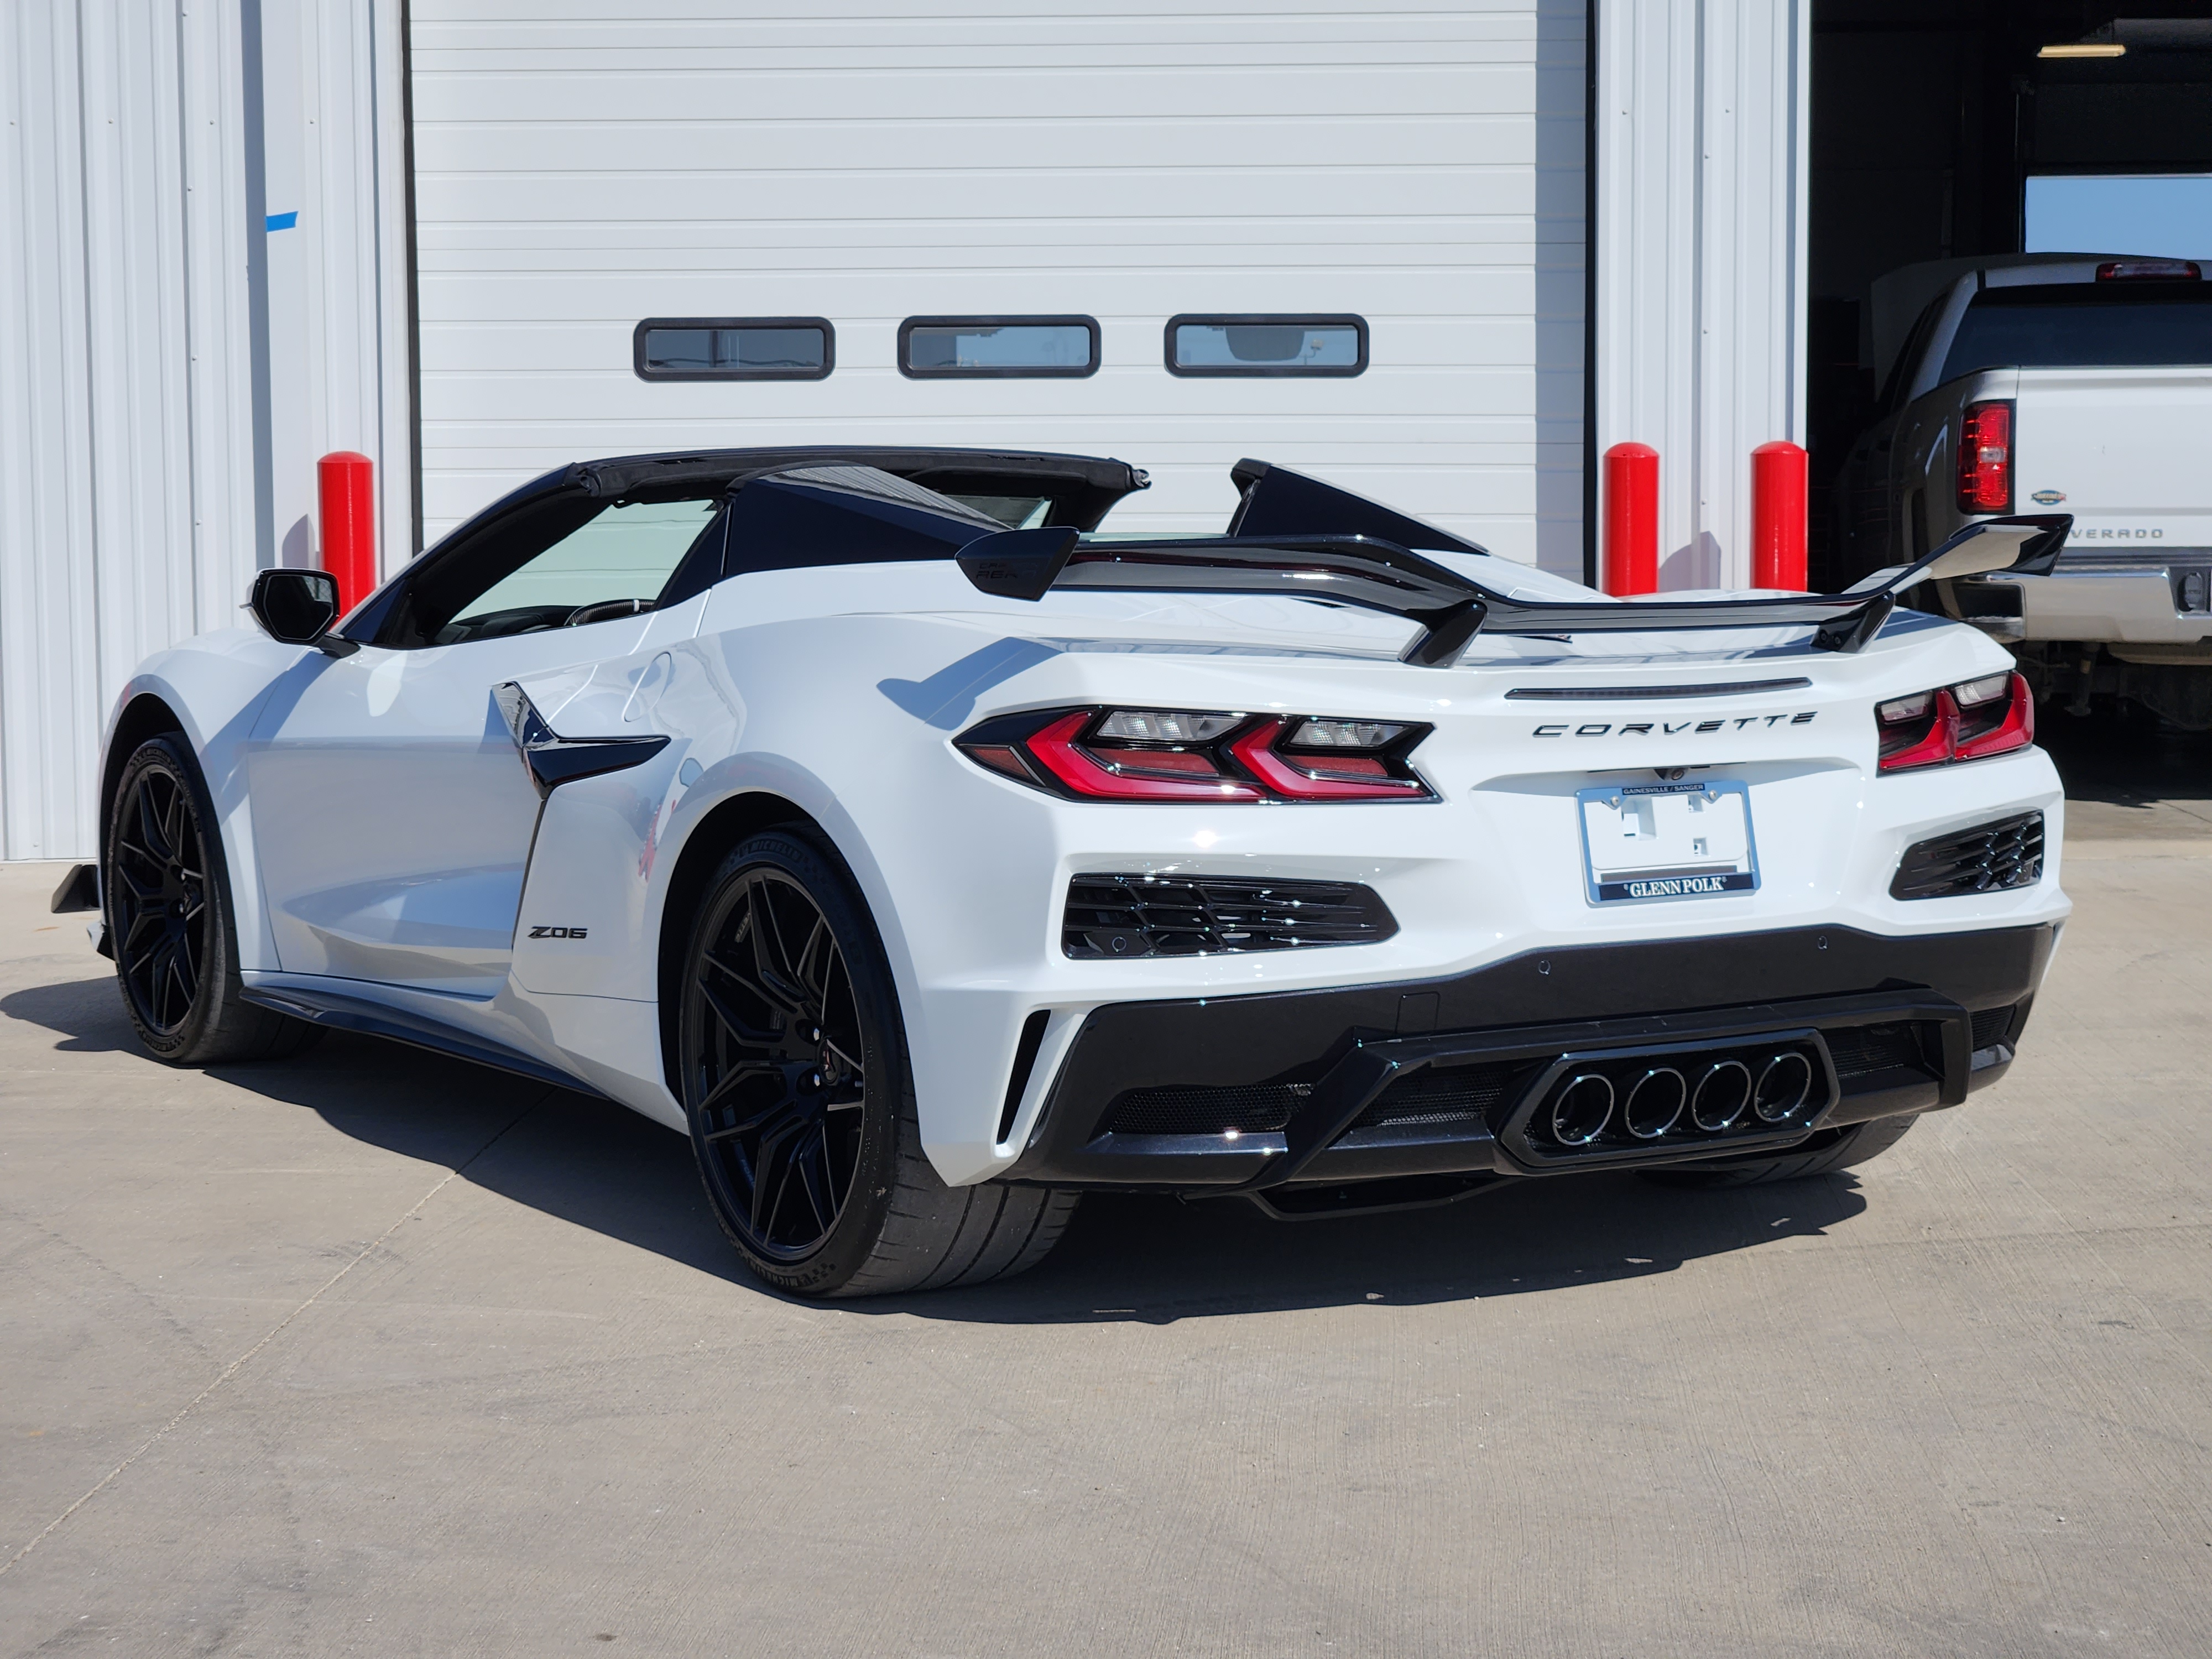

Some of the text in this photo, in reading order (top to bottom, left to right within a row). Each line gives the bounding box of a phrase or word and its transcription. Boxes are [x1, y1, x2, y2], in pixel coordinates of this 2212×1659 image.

[2070, 528, 2163, 539] VERADO
[1532, 711, 1818, 738] CORVETTE
[1629, 876, 1724, 898] GLENN POLK
[528, 926, 588, 939] Z06
